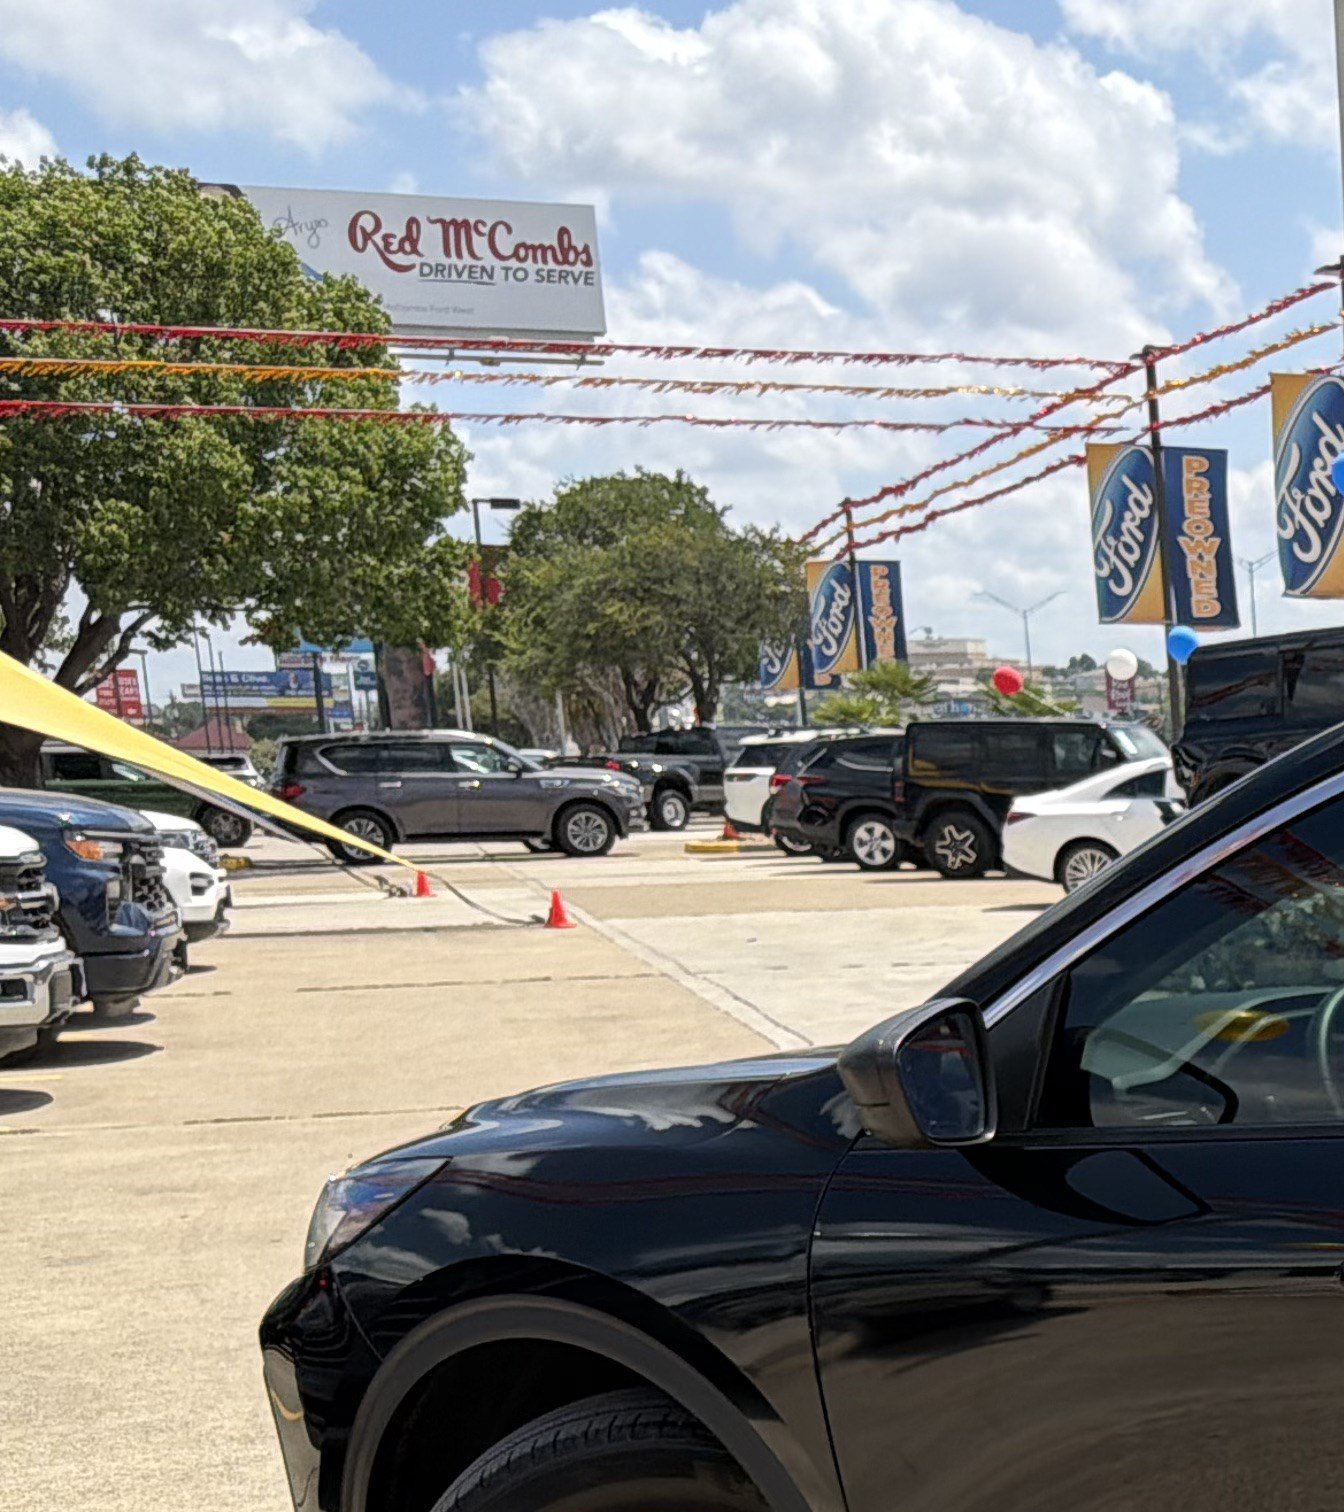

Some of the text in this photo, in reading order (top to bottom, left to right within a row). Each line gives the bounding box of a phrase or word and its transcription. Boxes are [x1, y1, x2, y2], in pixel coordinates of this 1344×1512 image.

[347, 209, 595, 273] Red McCombs
[418, 262, 595, 287] DRIVEN TO SERVE
[1094, 473, 1154, 597] Ford
[1176, 454, 1222, 619] PREOWNED
[812, 578, 852, 657] Ford
[867, 564, 898, 663] PREOWNE
